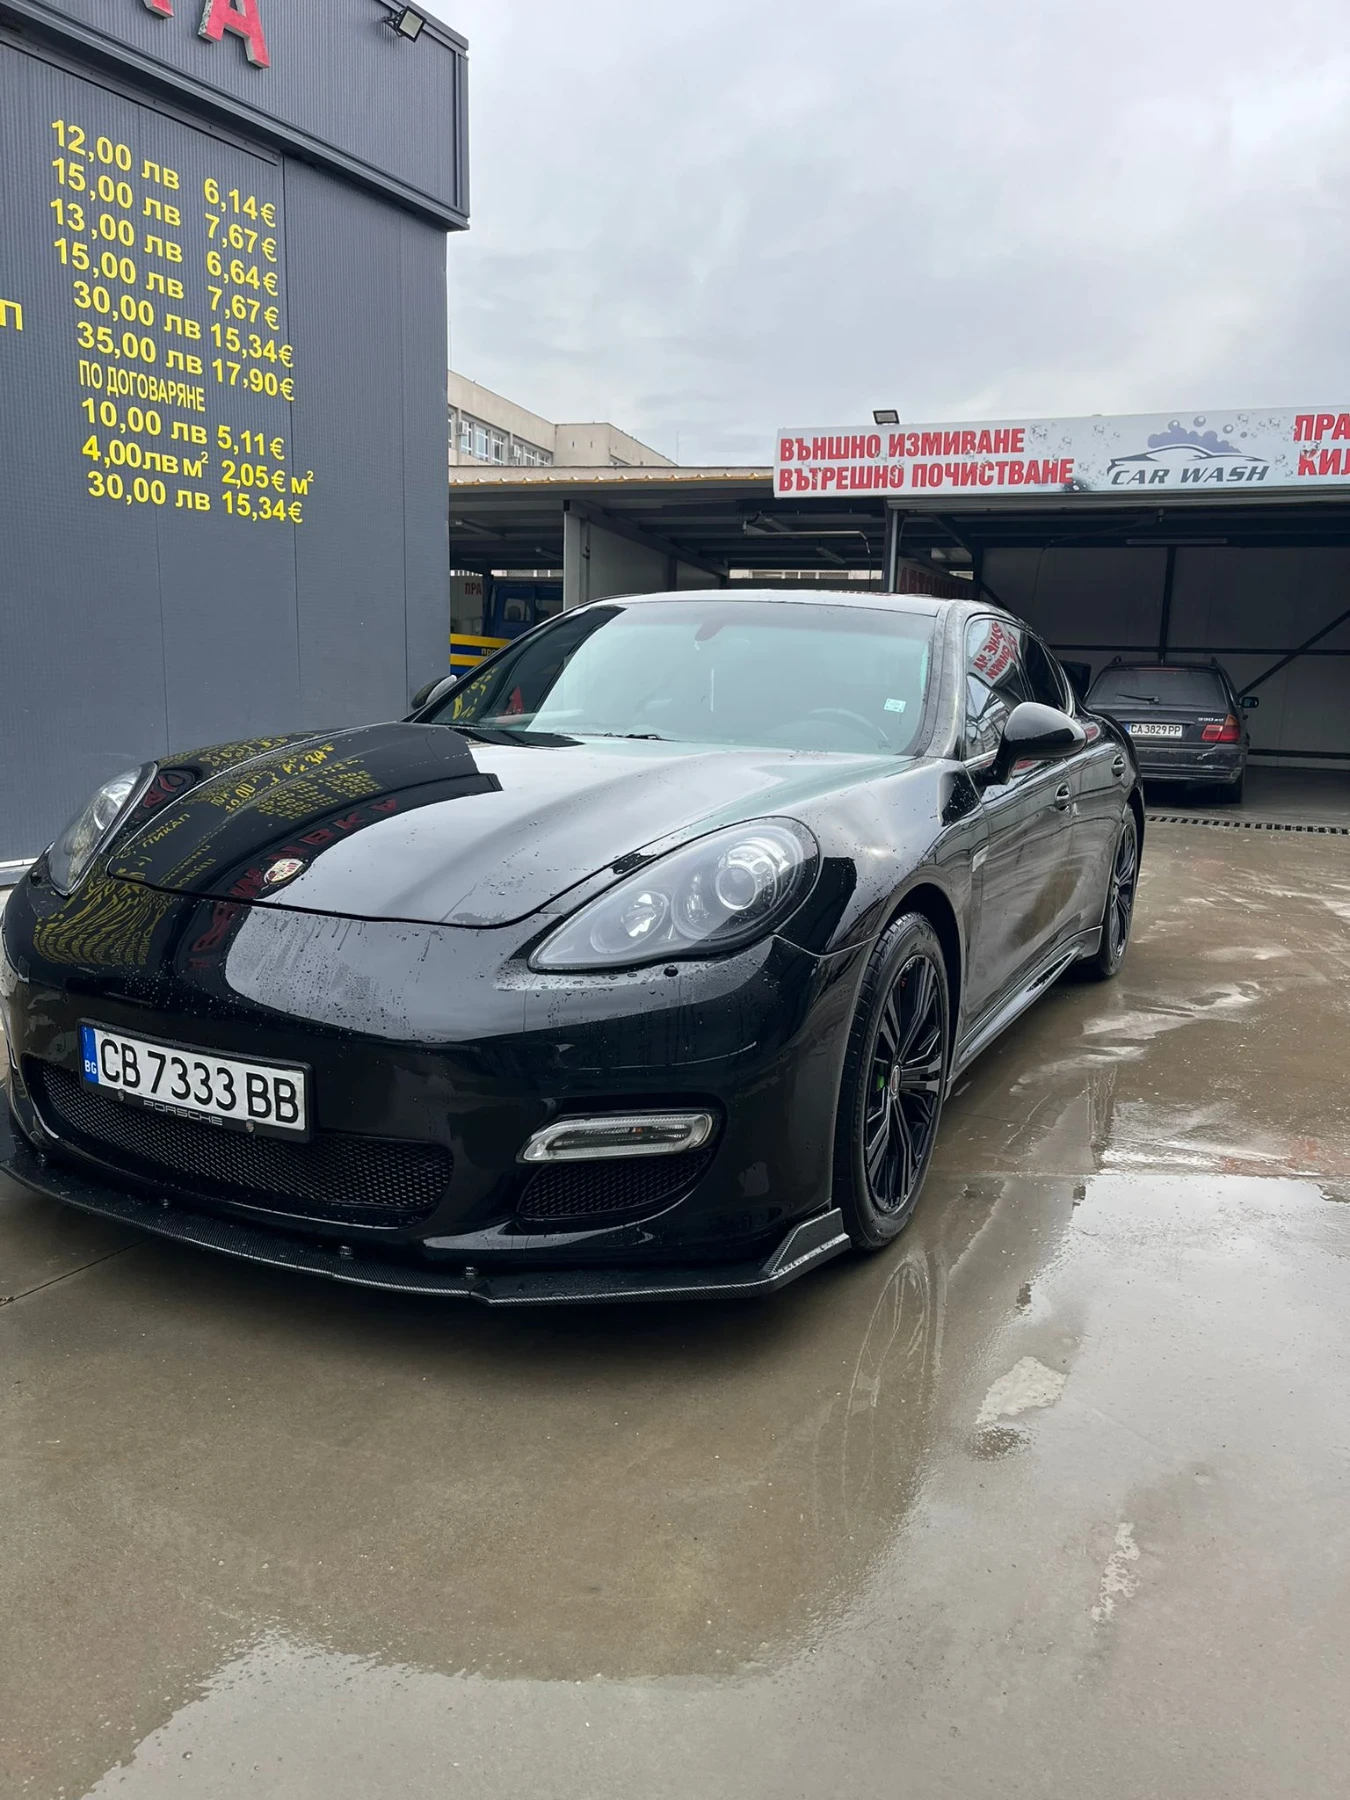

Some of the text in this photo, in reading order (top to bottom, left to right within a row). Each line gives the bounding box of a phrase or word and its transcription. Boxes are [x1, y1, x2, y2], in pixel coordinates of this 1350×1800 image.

[51, 119, 133, 172] 12,00
[142, 160, 180, 191] лв
[51, 157, 134, 210] 15,00
[143, 197, 182, 227] лв
[49, 198, 135, 248] 13,00
[144, 234, 184, 264] лв
[53, 238, 137, 285] 15,00
[145, 271, 185, 300] лв
[72, 280, 155, 328] 30,00
[163, 313, 202, 341] лв
[77, 321, 157, 364] 35,00
[165, 350, 204, 376] лв
[79, 359, 206, 413] ПО ДОГОВАРЯНЕ
[81, 397, 162, 437] 10,00
[170, 421, 208, 446] лв
[779, 428, 1026, 462] ВЪНШНО ИЗМИВАНЕ
[87, 470, 167, 506] 30,00
[175, 489, 212, 512] лв
[778, 458, 1075, 492] ВЪТРЕШНО ПОЧИСТВАНЕ
[1111, 465, 1270, 486] CAR WASH
[84, 1059, 98, 1076] BG
[143, 1099, 223, 1127] PORSCHE
